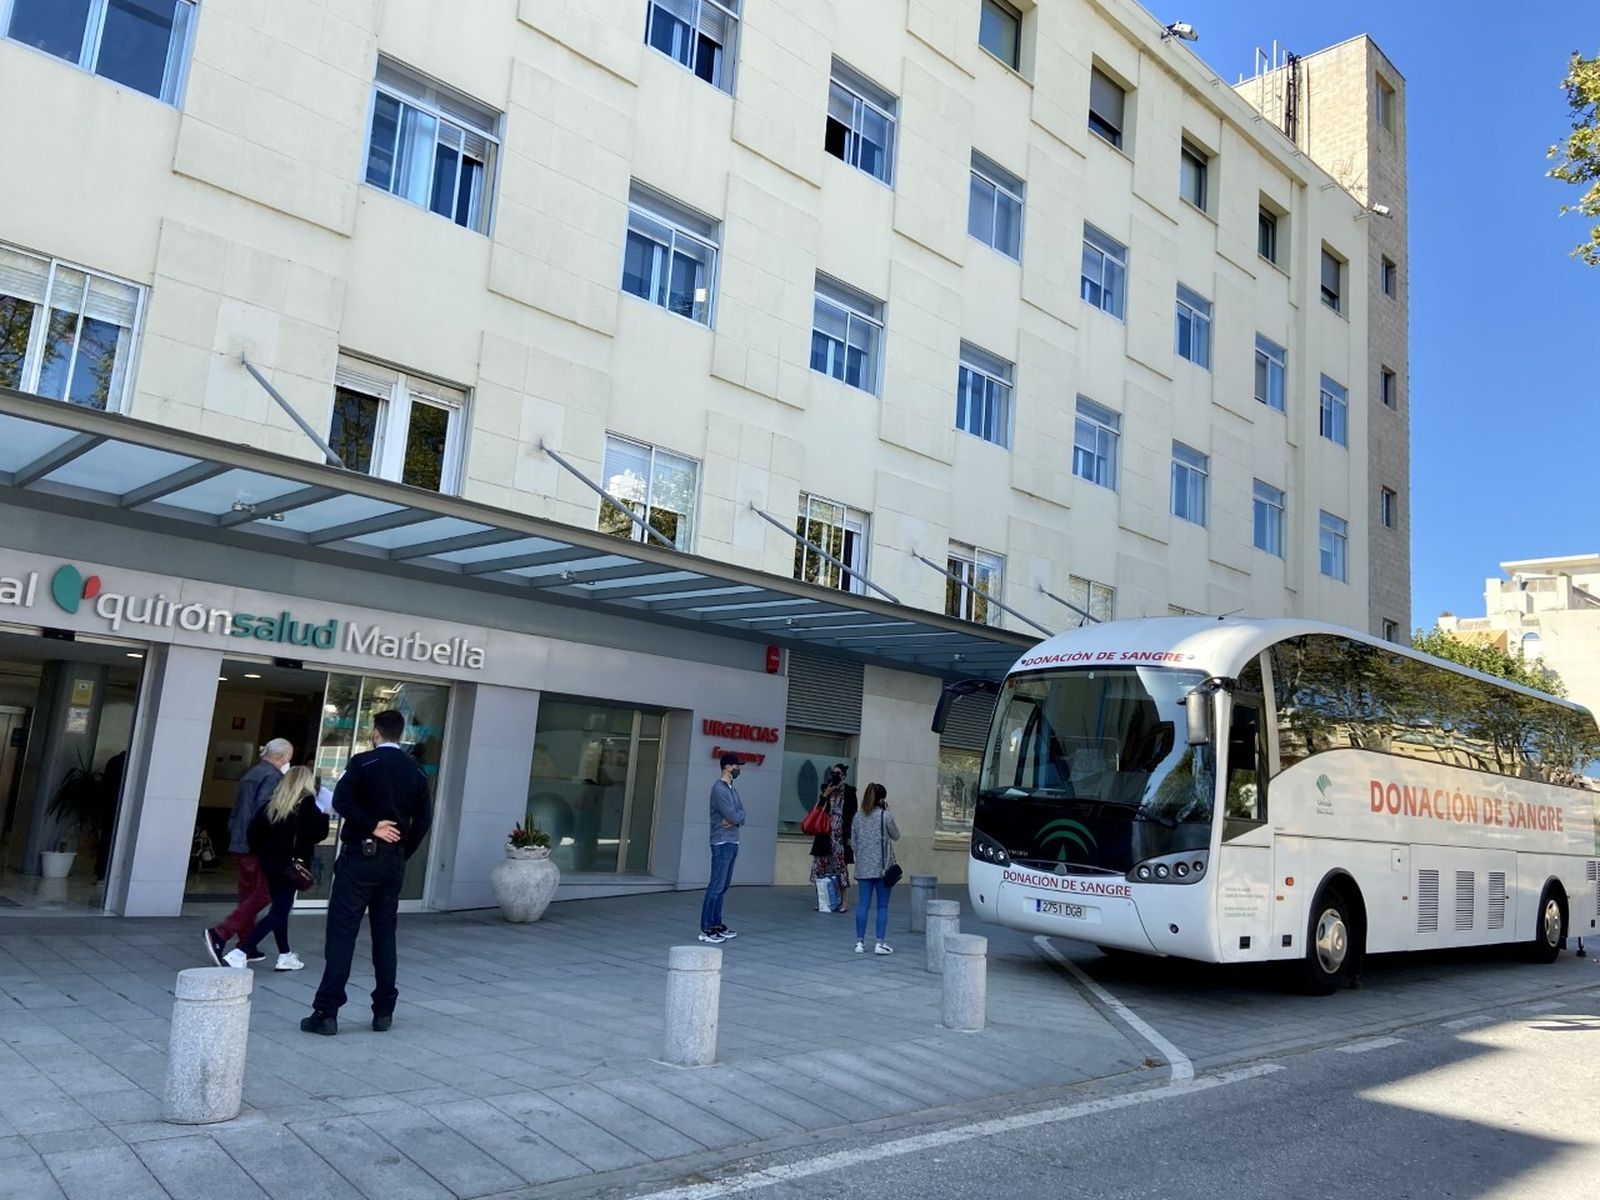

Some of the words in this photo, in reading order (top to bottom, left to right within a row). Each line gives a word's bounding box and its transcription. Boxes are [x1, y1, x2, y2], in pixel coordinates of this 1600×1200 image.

[344, 622, 485, 670] Marbella
[1025, 651, 1092, 667] DONACIÓN
[1096, 651, 1115, 661] DE
[1119, 651, 1184, 662] SANGRE
[703, 719, 779, 743] URGENCIAS
[1370, 781, 1478, 824] DONACIÓN
[1483, 797, 1504, 827] DE
[1508, 800, 1564, 832] SANGRE
[1003, 870, 1059, 888] DONACIÓN
[1061, 879, 1077, 891] DE
[1080, 881, 1132, 897] SANGRE
[1043, 902, 1063, 913] 2751
